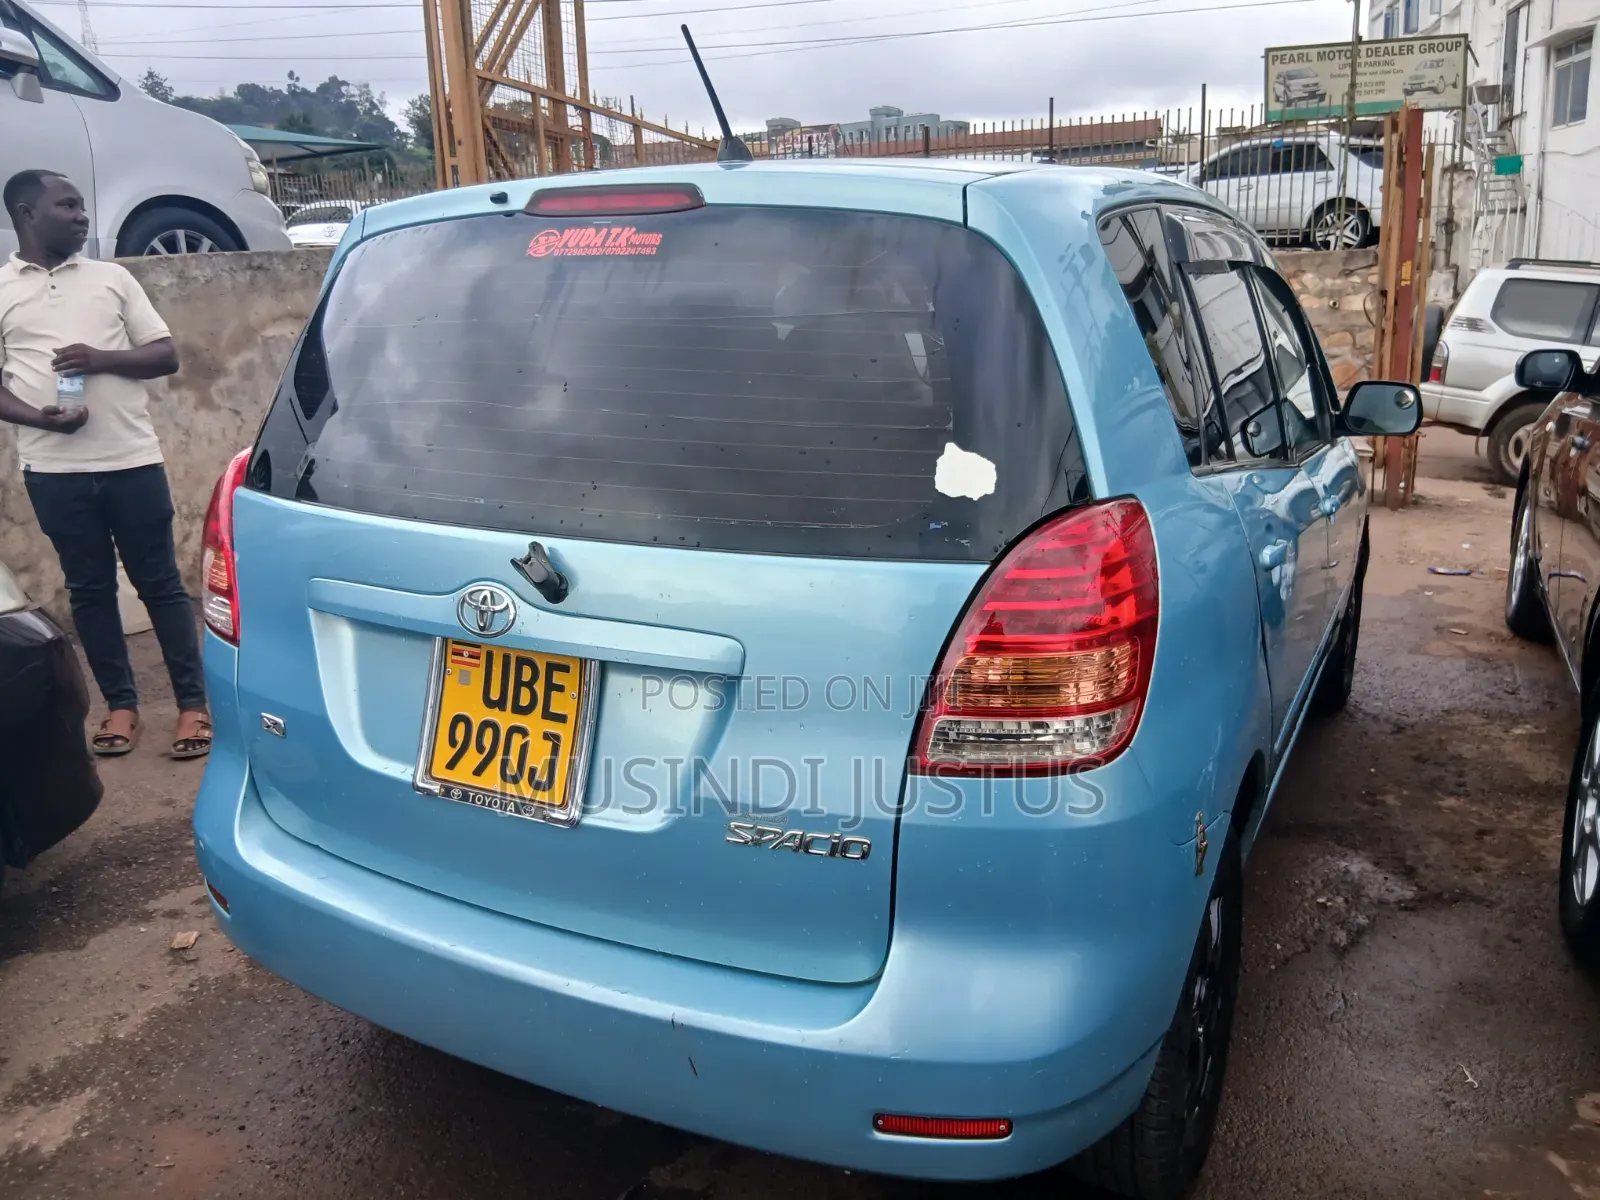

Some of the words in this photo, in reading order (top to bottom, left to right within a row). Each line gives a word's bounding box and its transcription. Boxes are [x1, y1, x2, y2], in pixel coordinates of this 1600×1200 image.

[1271, 51, 1312, 66] PEARL
[1316, 48, 1362, 62] MOTOR
[1365, 44, 1415, 59] DEALER
[1418, 40, 1463, 55] GROUP
[1338, 61, 1363, 71] UPPR
[1363, 59, 1396, 68] PARKING
[558, 227, 608, 248] YUDA
[628, 233, 663, 246] MOTORS
[482, 649, 571, 724] UBE
[445, 713, 562, 793] 990J
[468, 791, 516, 813] TOYOTA
